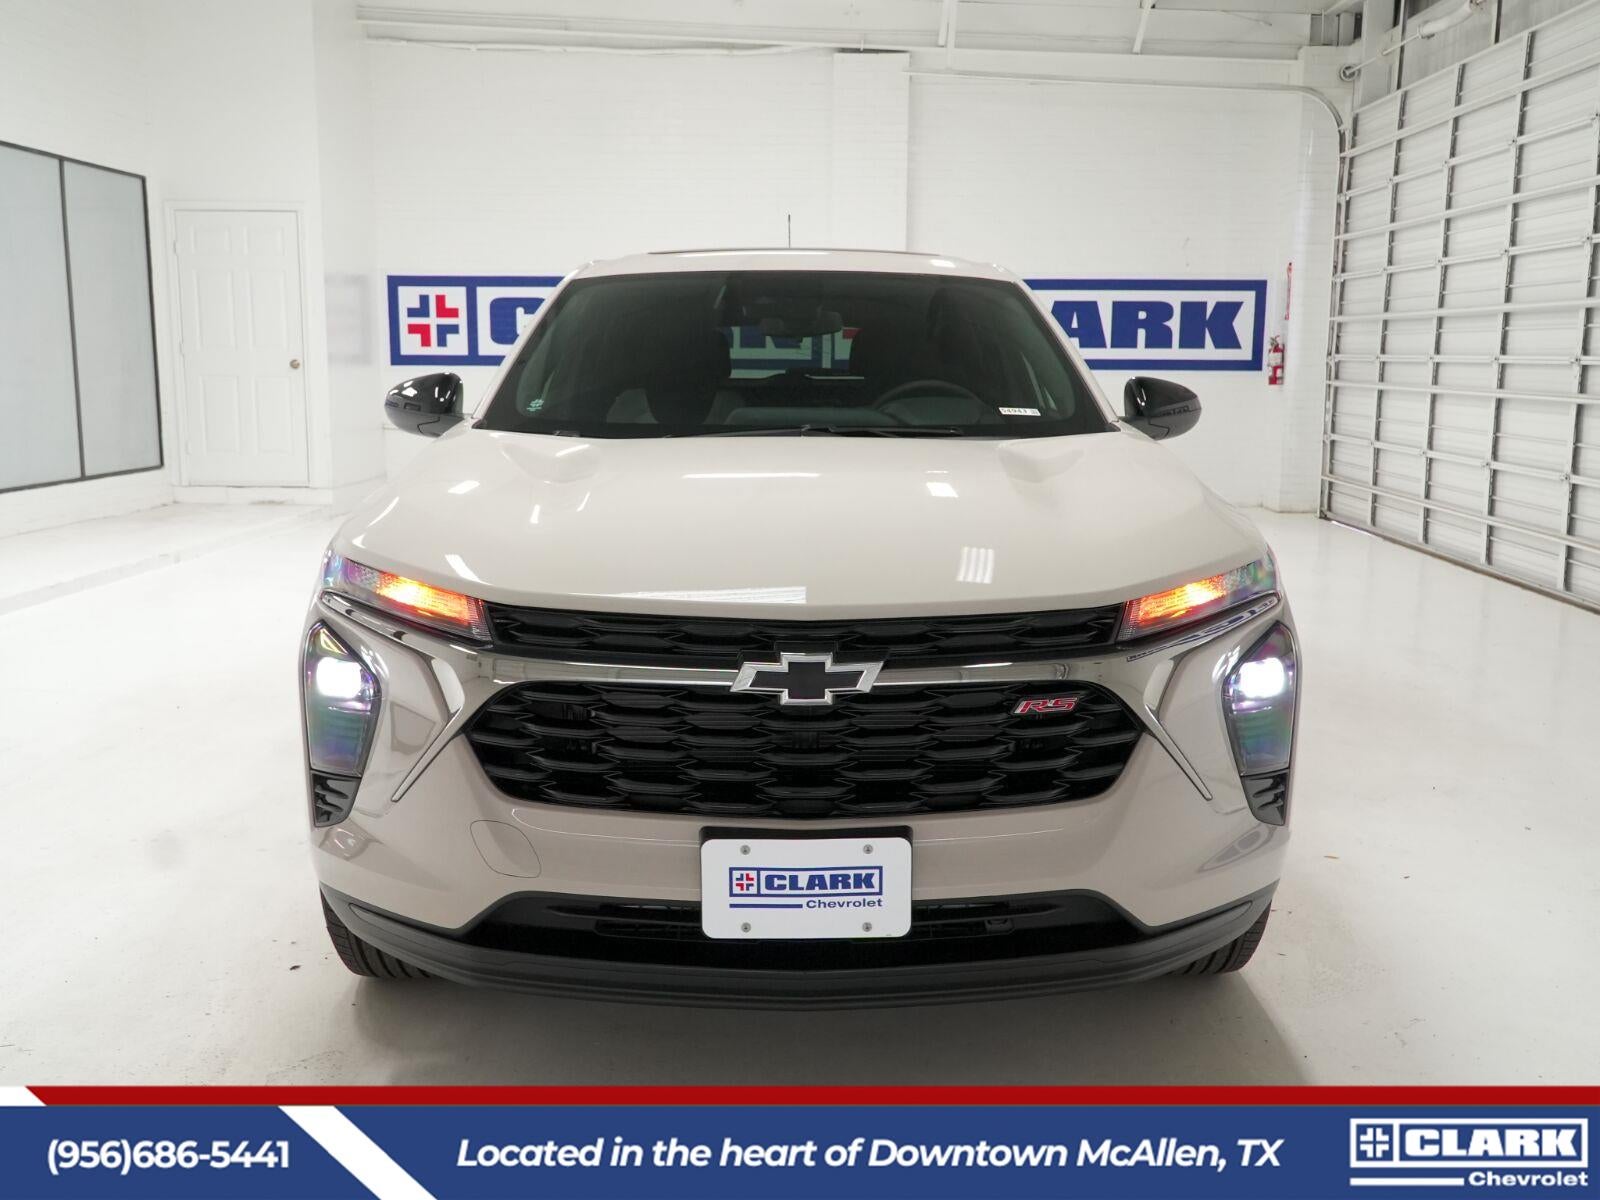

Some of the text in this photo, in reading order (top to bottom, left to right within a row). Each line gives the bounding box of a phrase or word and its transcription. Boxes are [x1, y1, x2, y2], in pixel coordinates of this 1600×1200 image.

[1051, 300, 1244, 349] ARK
[1014, 697, 1078, 714] RS
[764, 872, 876, 892] CLARK
[805, 898, 883, 909] Chevrolet
